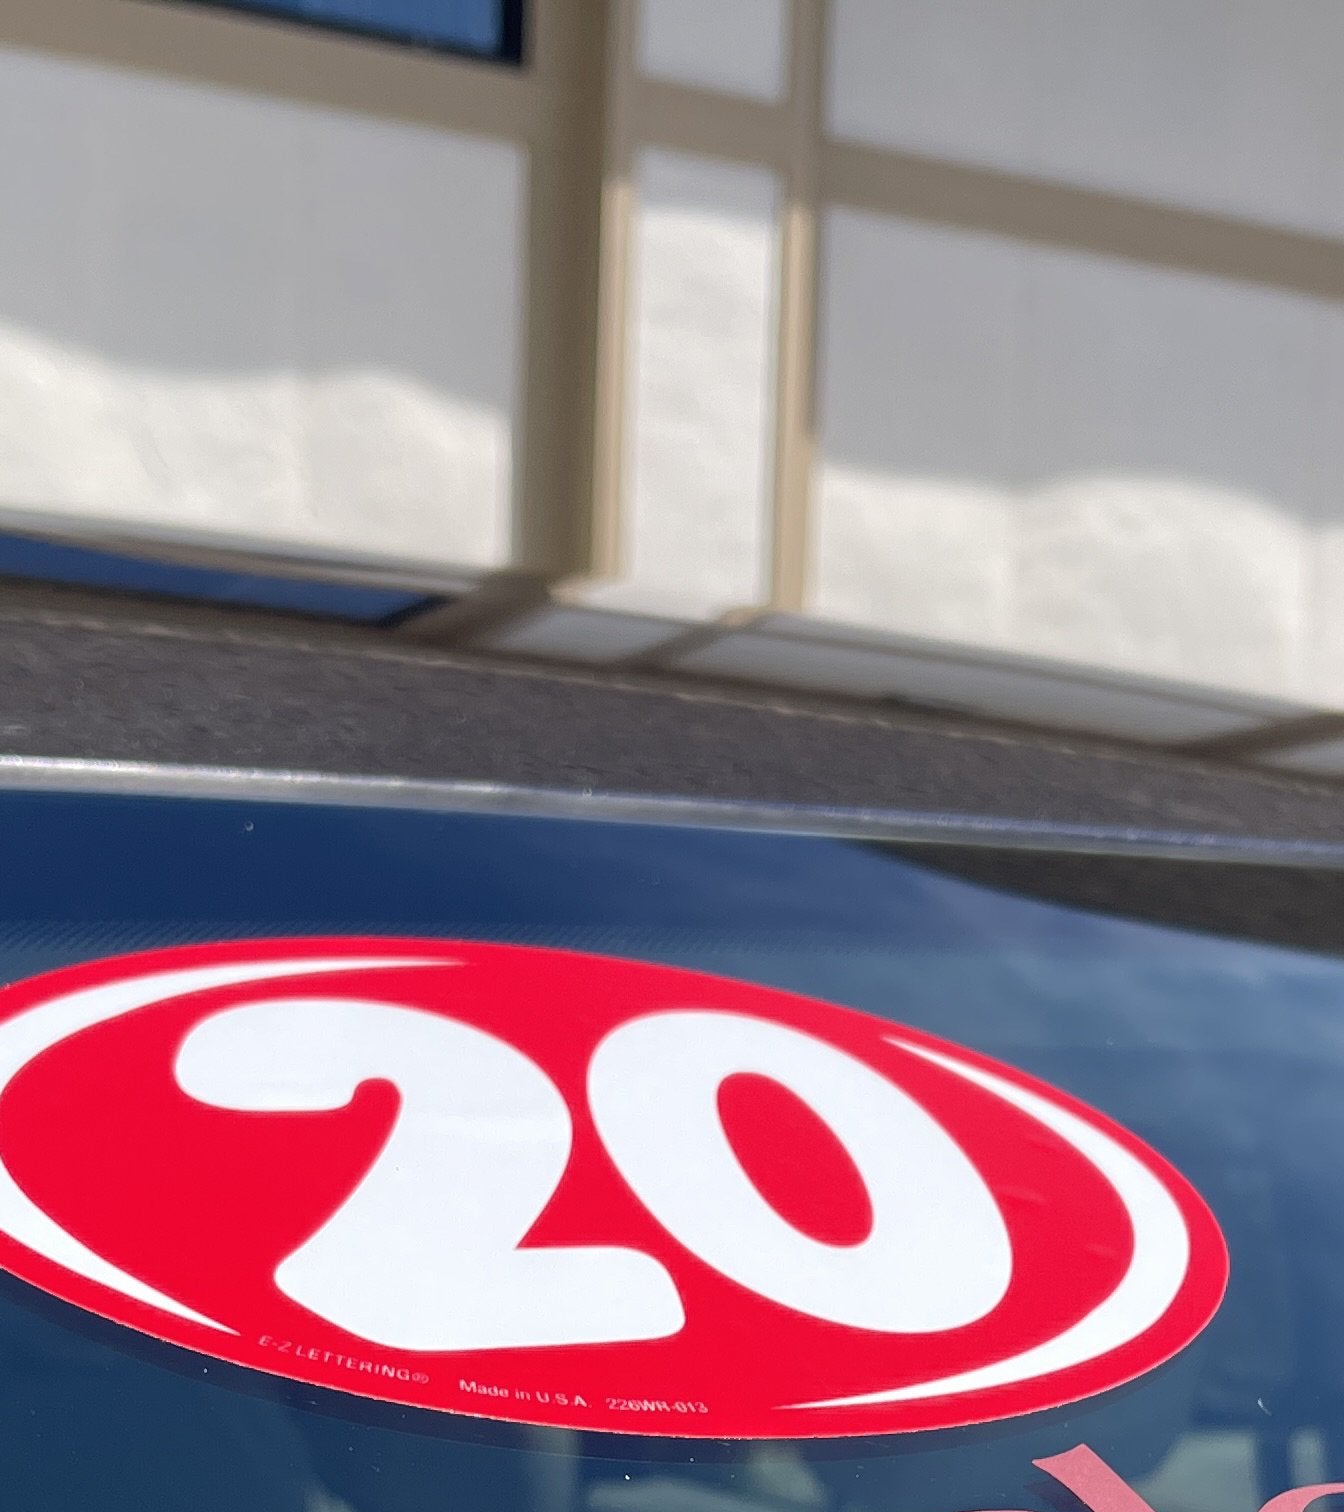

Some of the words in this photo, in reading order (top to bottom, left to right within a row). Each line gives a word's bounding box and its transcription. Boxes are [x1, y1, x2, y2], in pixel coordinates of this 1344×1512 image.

[174, 997, 1014, 1352] 20
[458, 1379, 508, 1398] Made
[514, 1387, 531, 1401] in
